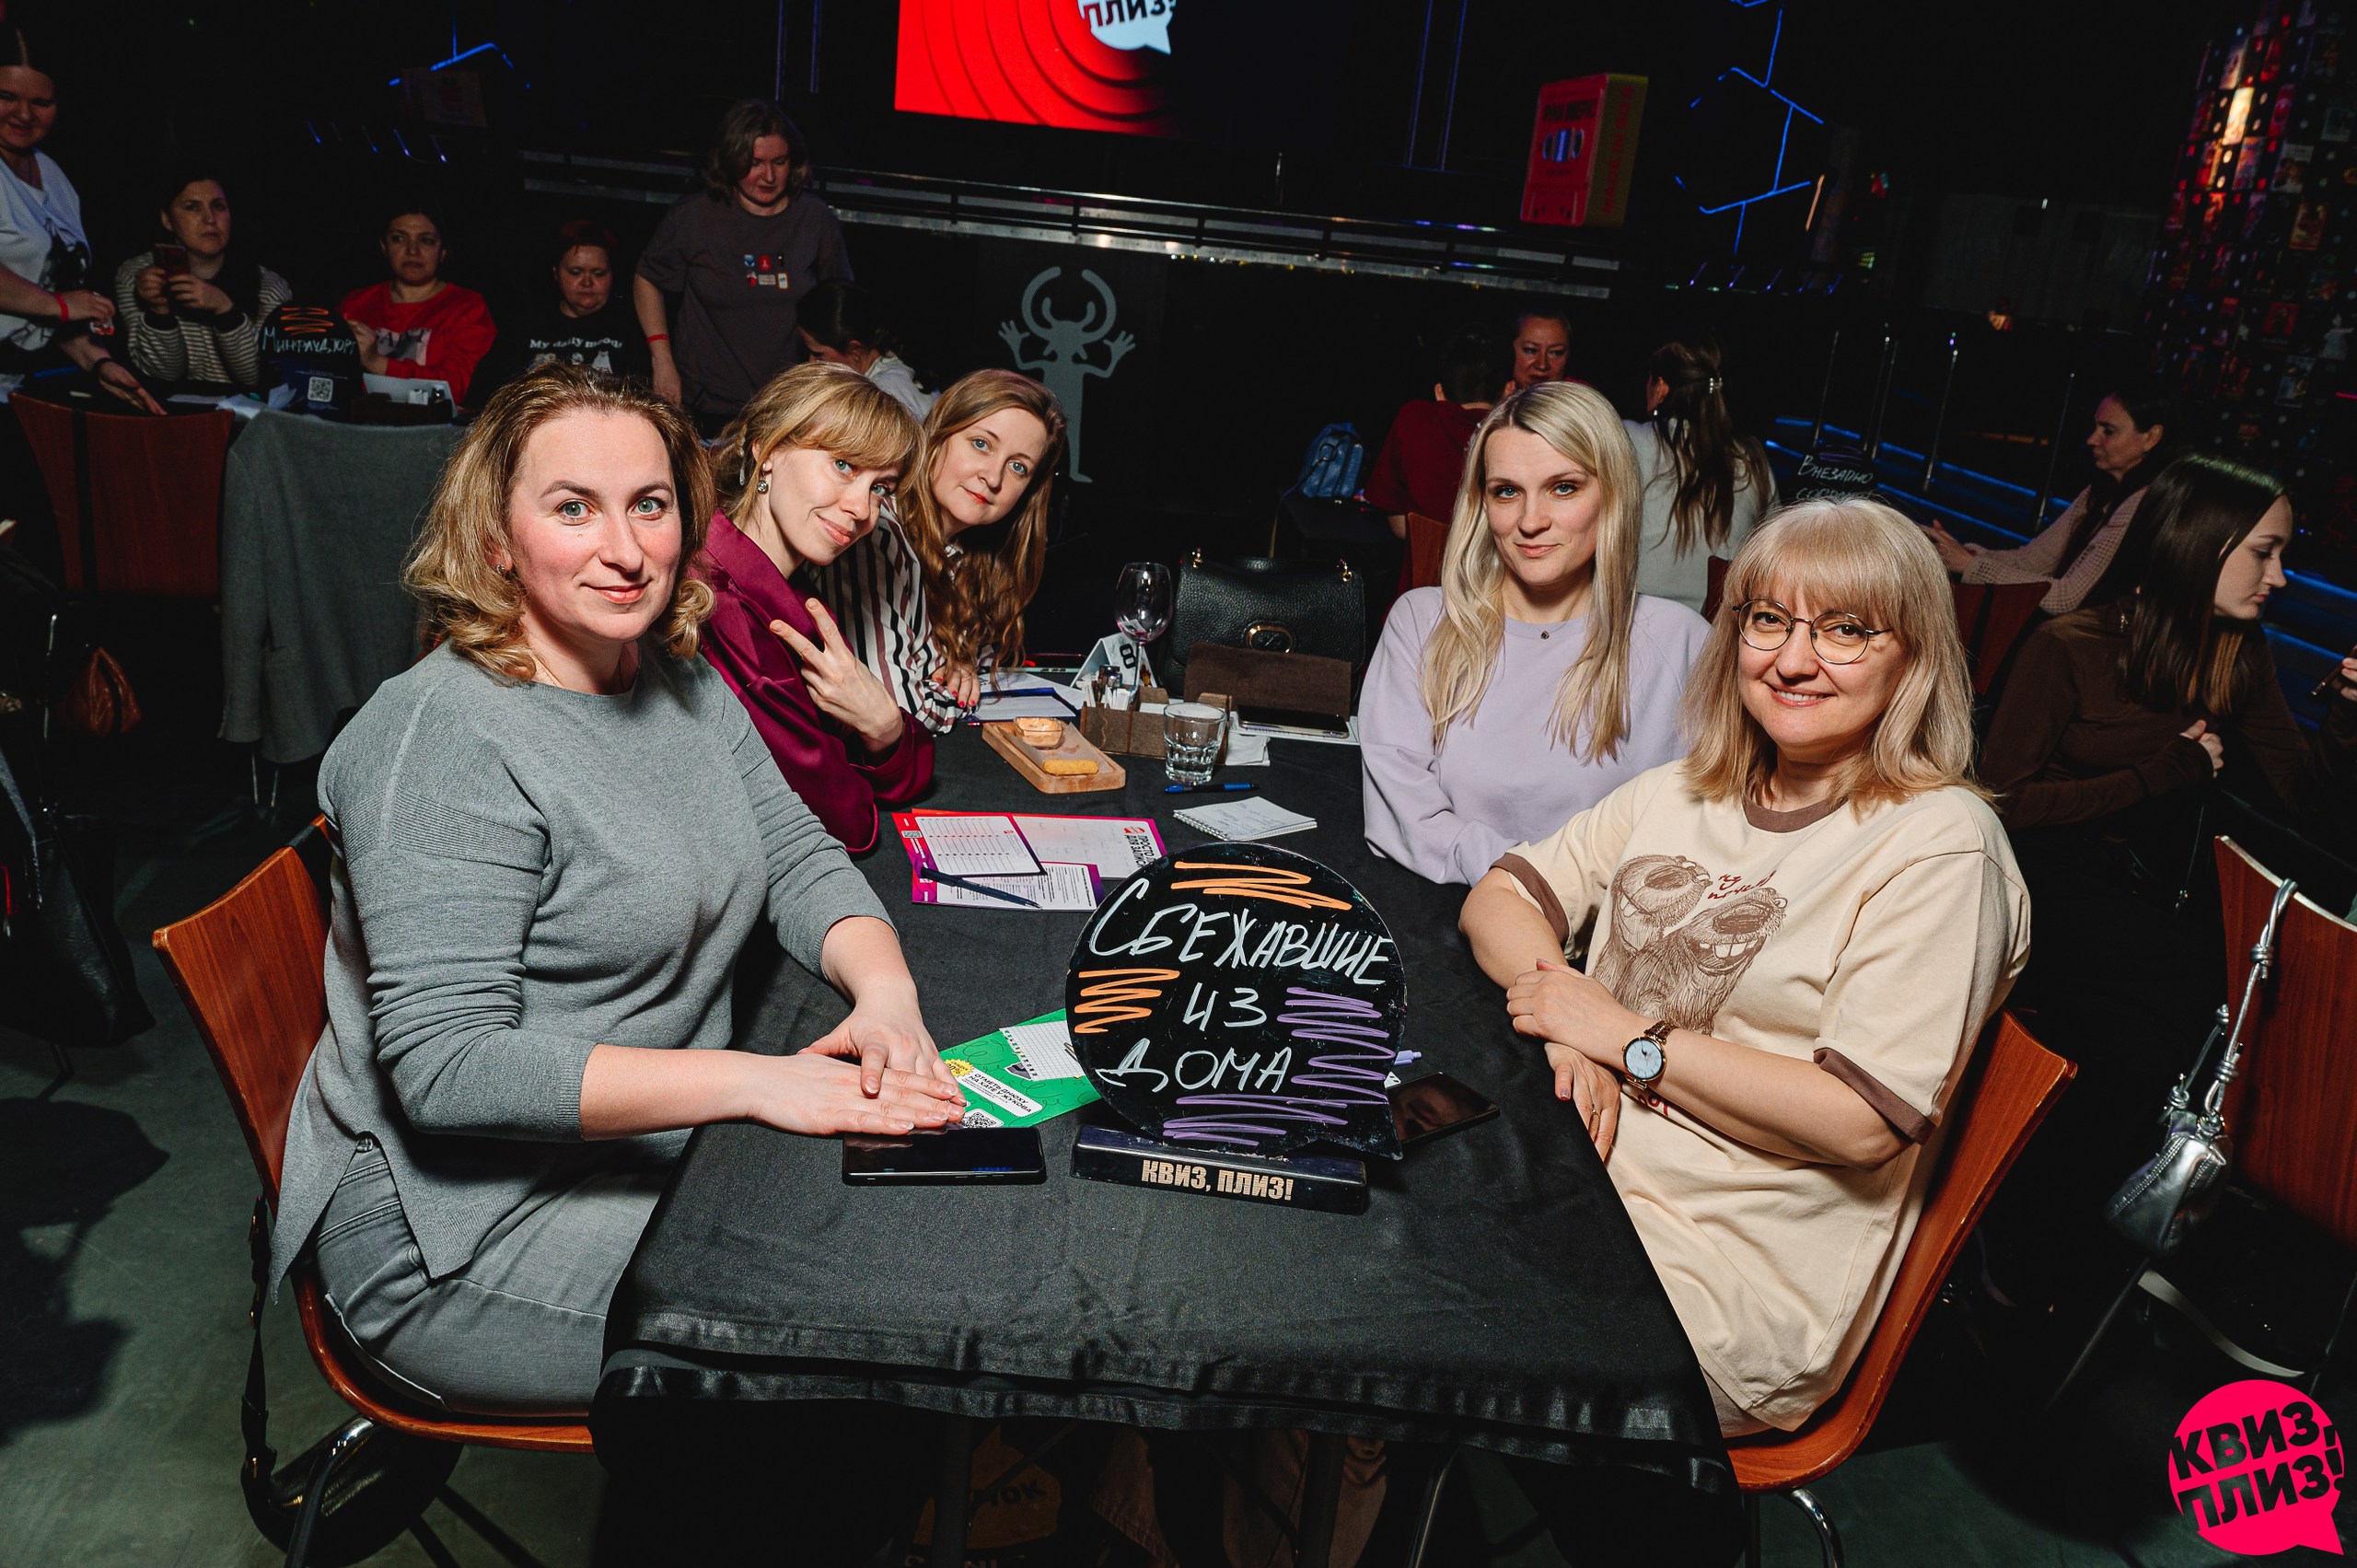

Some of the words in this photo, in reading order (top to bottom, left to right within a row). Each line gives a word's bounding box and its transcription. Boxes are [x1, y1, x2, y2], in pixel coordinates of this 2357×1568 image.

[530, 339, 550, 349] My
[552, 337, 584, 348] daily
[1120, 644, 1136, 669] 8
[1137, 835, 1155, 857] ПРОСТО
[1183, 982, 1268, 1031] ИЗ
[1095, 1038, 1292, 1093] ДОМА
[969, 1075, 980, 1085] НА
[979, 1081, 996, 1094] ХАТЕ
[1001, 1094, 1031, 1112] ЖУКОВА
[974, 1073, 1002, 1090] ОТМЕТЬ
[1000, 1088, 1028, 1104] ДНЮХУ
[1141, 1159, 1211, 1191] КВИЗ,
[1216, 1169, 1295, 1201] ПЛИЗ!
